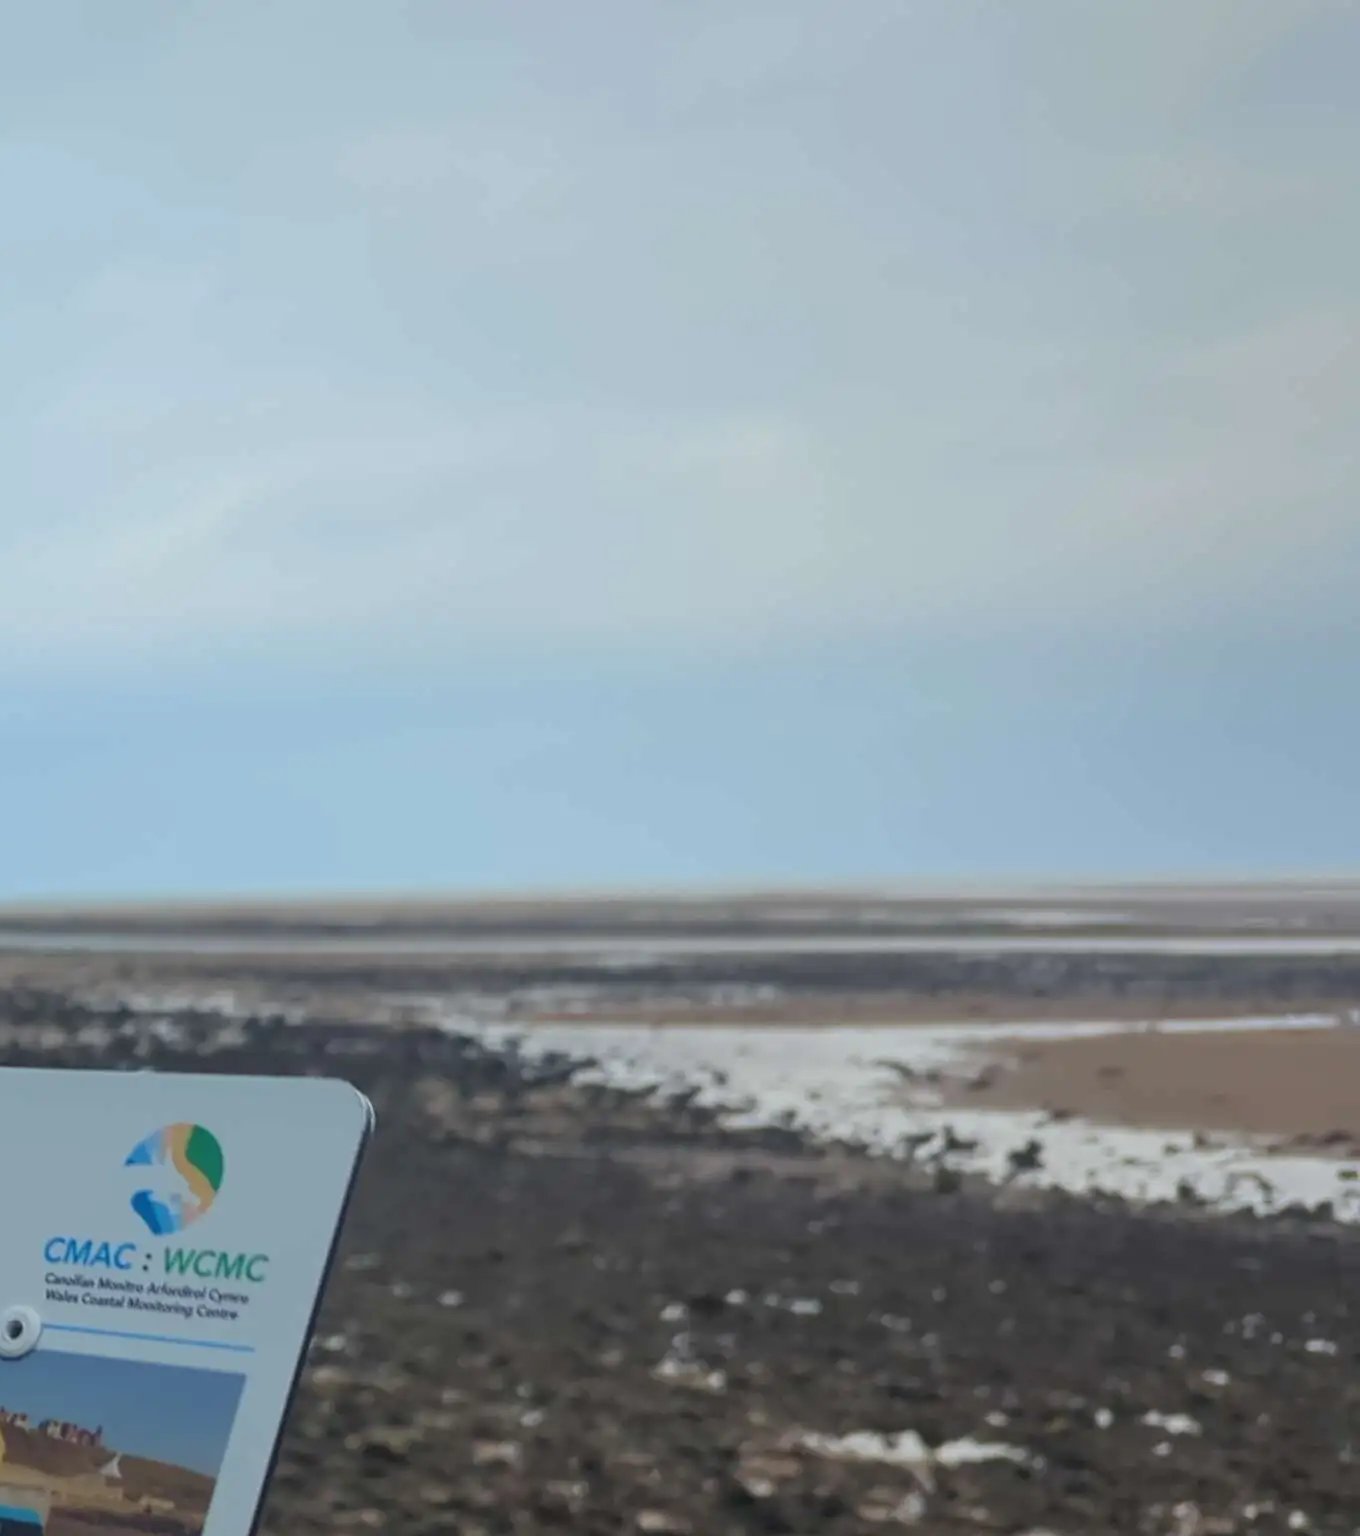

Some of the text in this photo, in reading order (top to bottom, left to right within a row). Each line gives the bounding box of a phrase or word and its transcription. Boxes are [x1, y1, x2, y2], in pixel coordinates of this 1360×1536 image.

[44, 1237, 137, 1270] CMAC
[164, 1247, 269, 1282] WCMC
[45, 1288, 79, 1304] Wales
